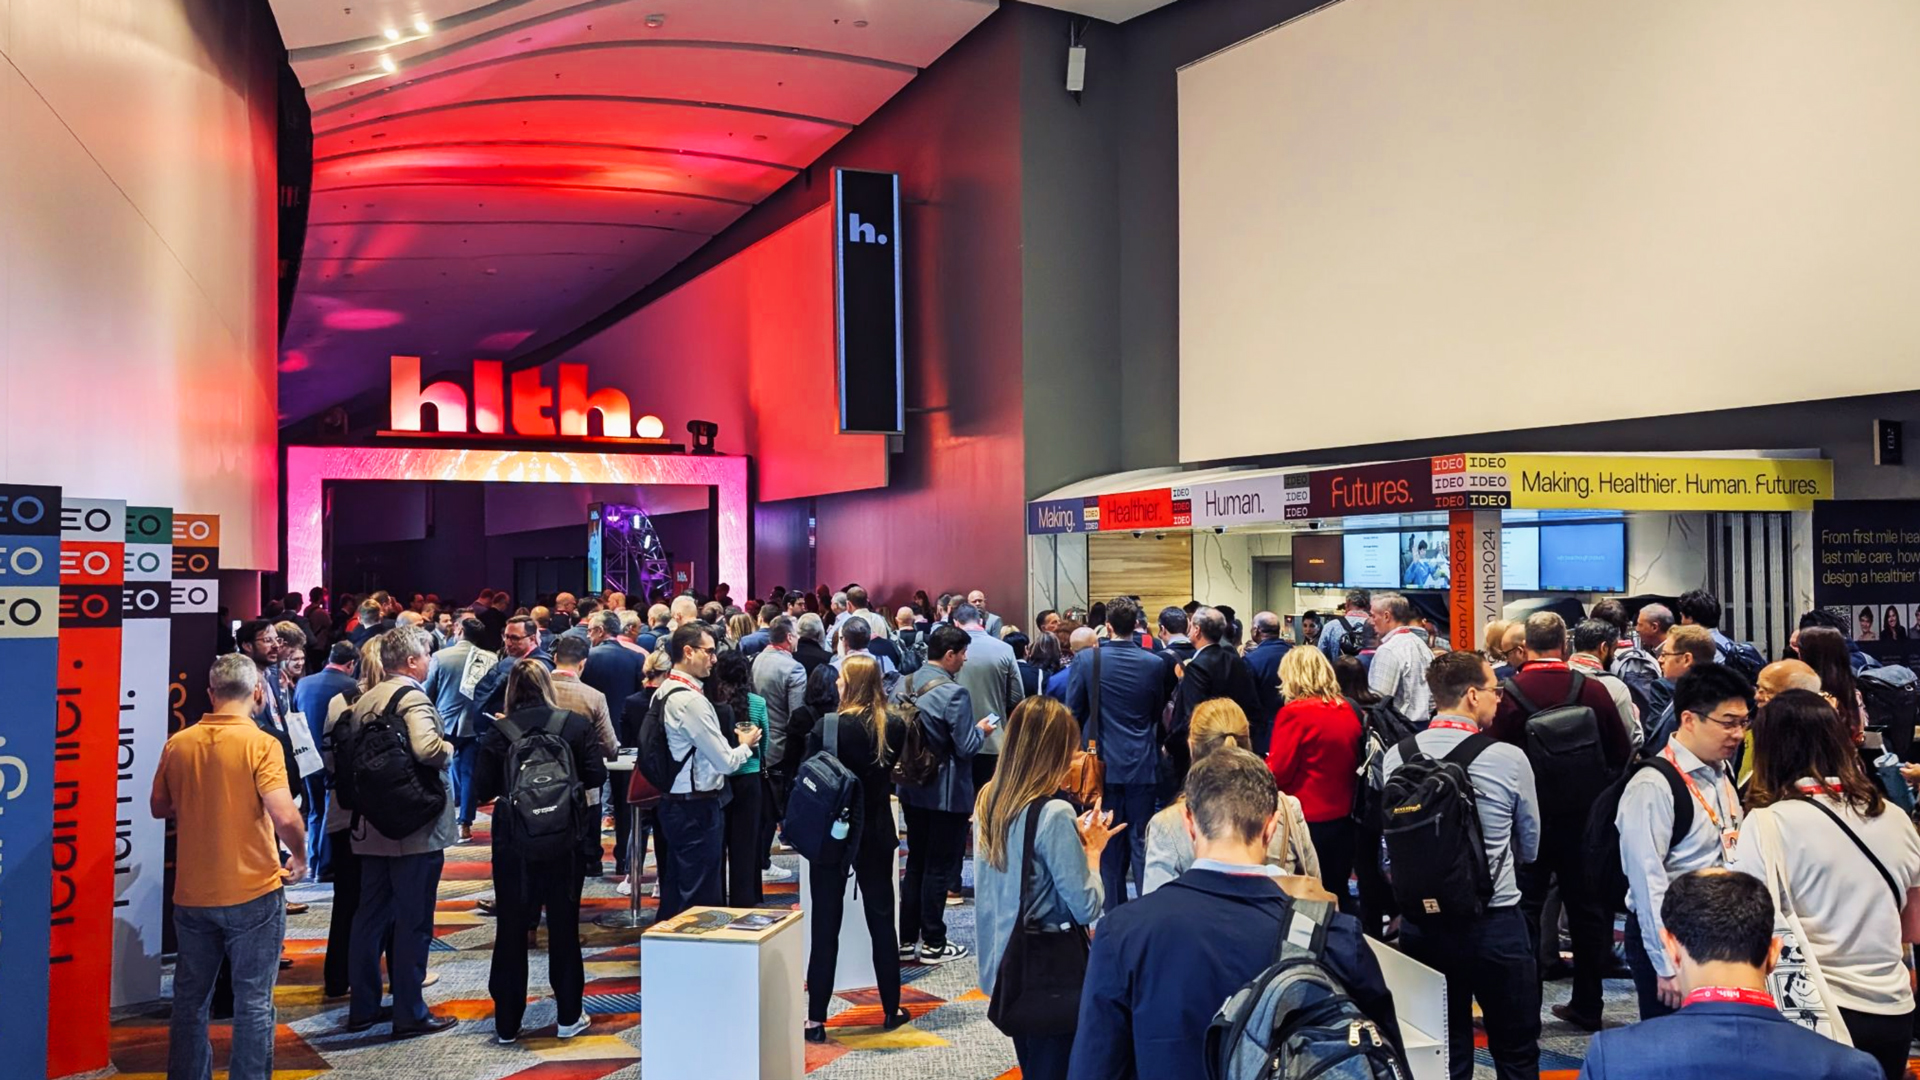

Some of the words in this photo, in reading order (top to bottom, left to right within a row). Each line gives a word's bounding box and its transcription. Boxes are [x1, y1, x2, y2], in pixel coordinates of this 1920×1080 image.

[849, 213, 887, 245] h.
[390, 355, 664, 438] hlth.
[1434, 457, 1464, 471] IDEO
[1469, 457, 1507, 468] IDEO
[1285, 474, 1308, 485] IDEO
[1435, 476, 1464, 489] IDEO
[1469, 476, 1507, 487] IDEO
[1522, 471, 1594, 499] Making.
[1599, 472, 1682, 494] Healthier.
[1686, 473, 1752, 495] Human.
[1755, 473, 1820, 495] Futures.
[1172, 488, 1190, 497] IDEO
[1286, 491, 1308, 502] IDEO
[1331, 477, 1414, 508] Futures.
[1173, 501, 1190, 511] IDEO
[1205, 490, 1265, 517] Human.
[1435, 495, 1465, 508] IDEO
[1470, 495, 1507, 506] IDEO
[0, 495, 45, 525] O
[1085, 510, 1099, 519] IDEO
[1107, 497, 1163, 524] Healthier.
[1286, 507, 1309, 518] IDEO
[1038, 505, 1076, 532] Making.
[1173, 515, 1190, 525] IDEO
[1085, 522, 1098, 530] IDEO
[1821, 529, 1851, 544] From
[1853, 529, 1875, 544] first
[1876, 529, 1898, 544] mile
[0, 546, 43, 575] O
[1821, 549, 1842, 564] last
[1844, 549, 1867, 564] mile
[1868, 552, 1895, 565] care,
[1822, 569, 1859, 588] design
[1861, 573, 1868, 583] a
[1870, 568, 1916, 583] healthier
[0, 597, 42, 626] O
